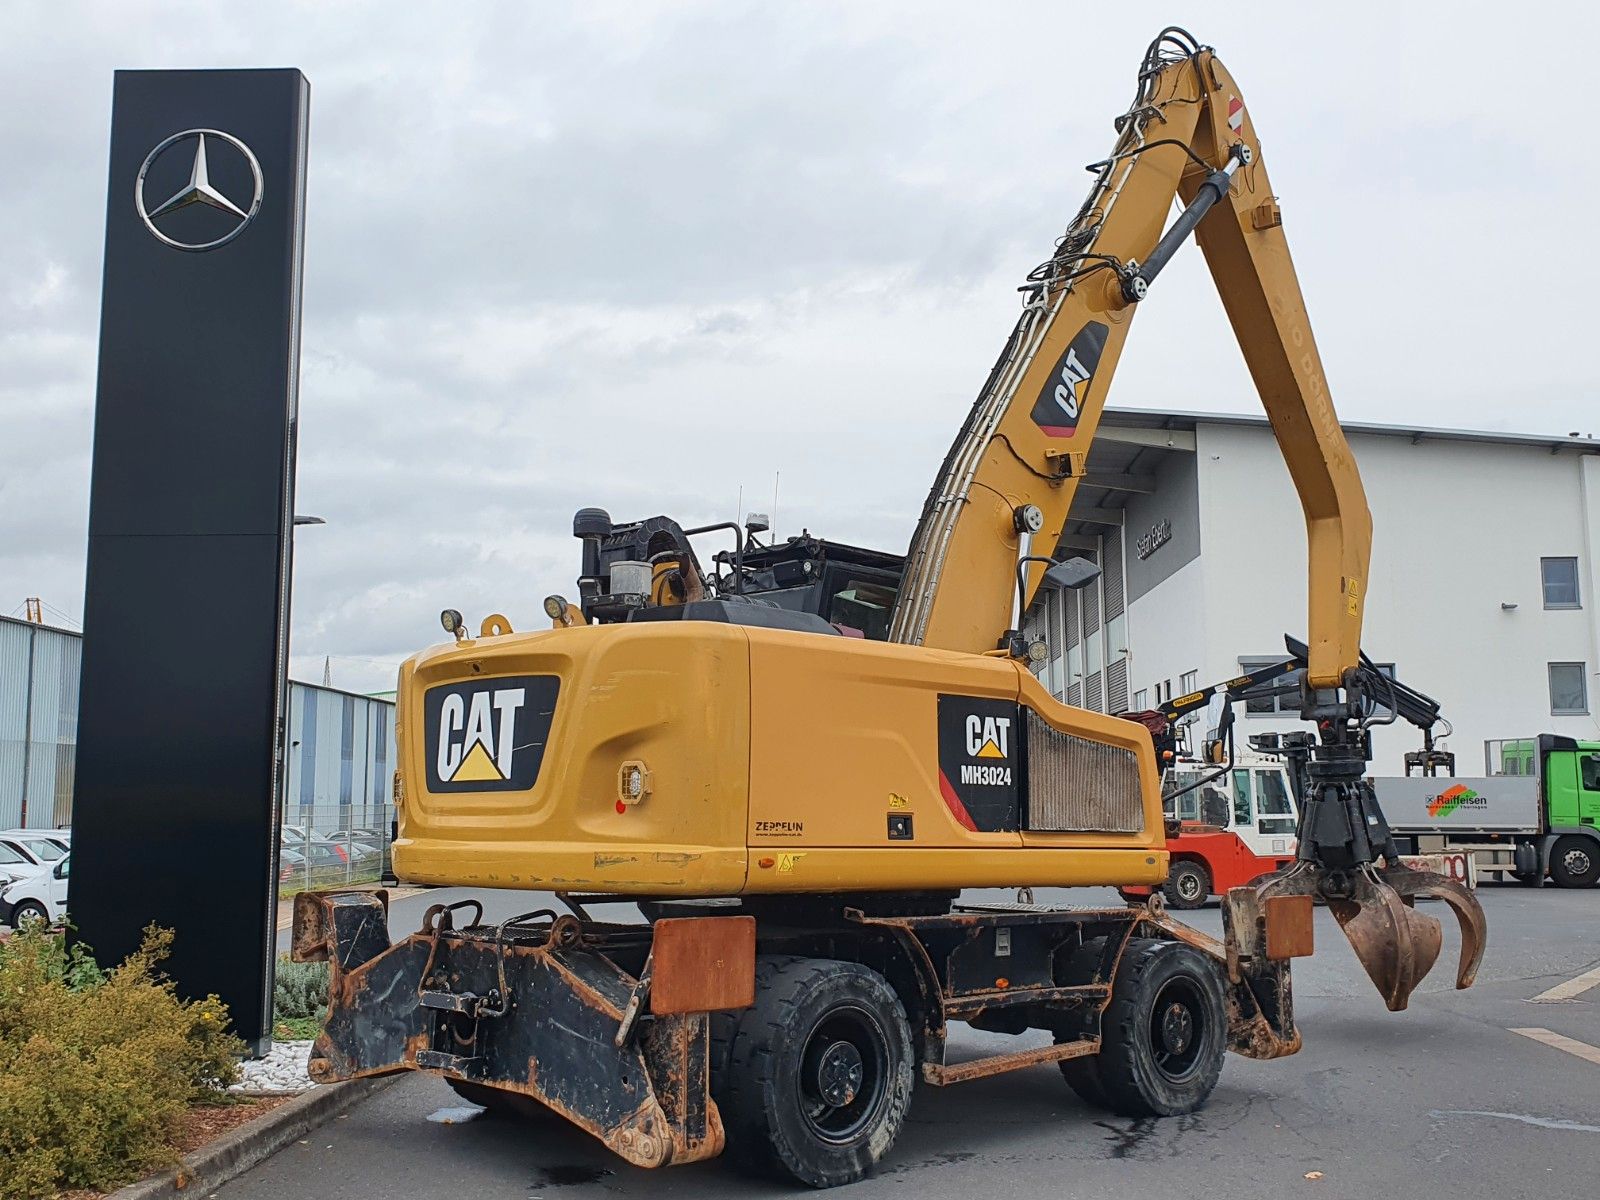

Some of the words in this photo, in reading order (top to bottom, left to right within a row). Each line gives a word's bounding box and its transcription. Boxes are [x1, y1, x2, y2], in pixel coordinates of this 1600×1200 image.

[1054, 347, 1091, 418] CAT
[437, 688, 525, 782] CAT
[966, 714, 1011, 758] CAT
[961, 765, 1012, 786] MH3024
[1436, 794, 1487, 805] Raiffeisen
[755, 821, 803, 832] ZEPPELIN
